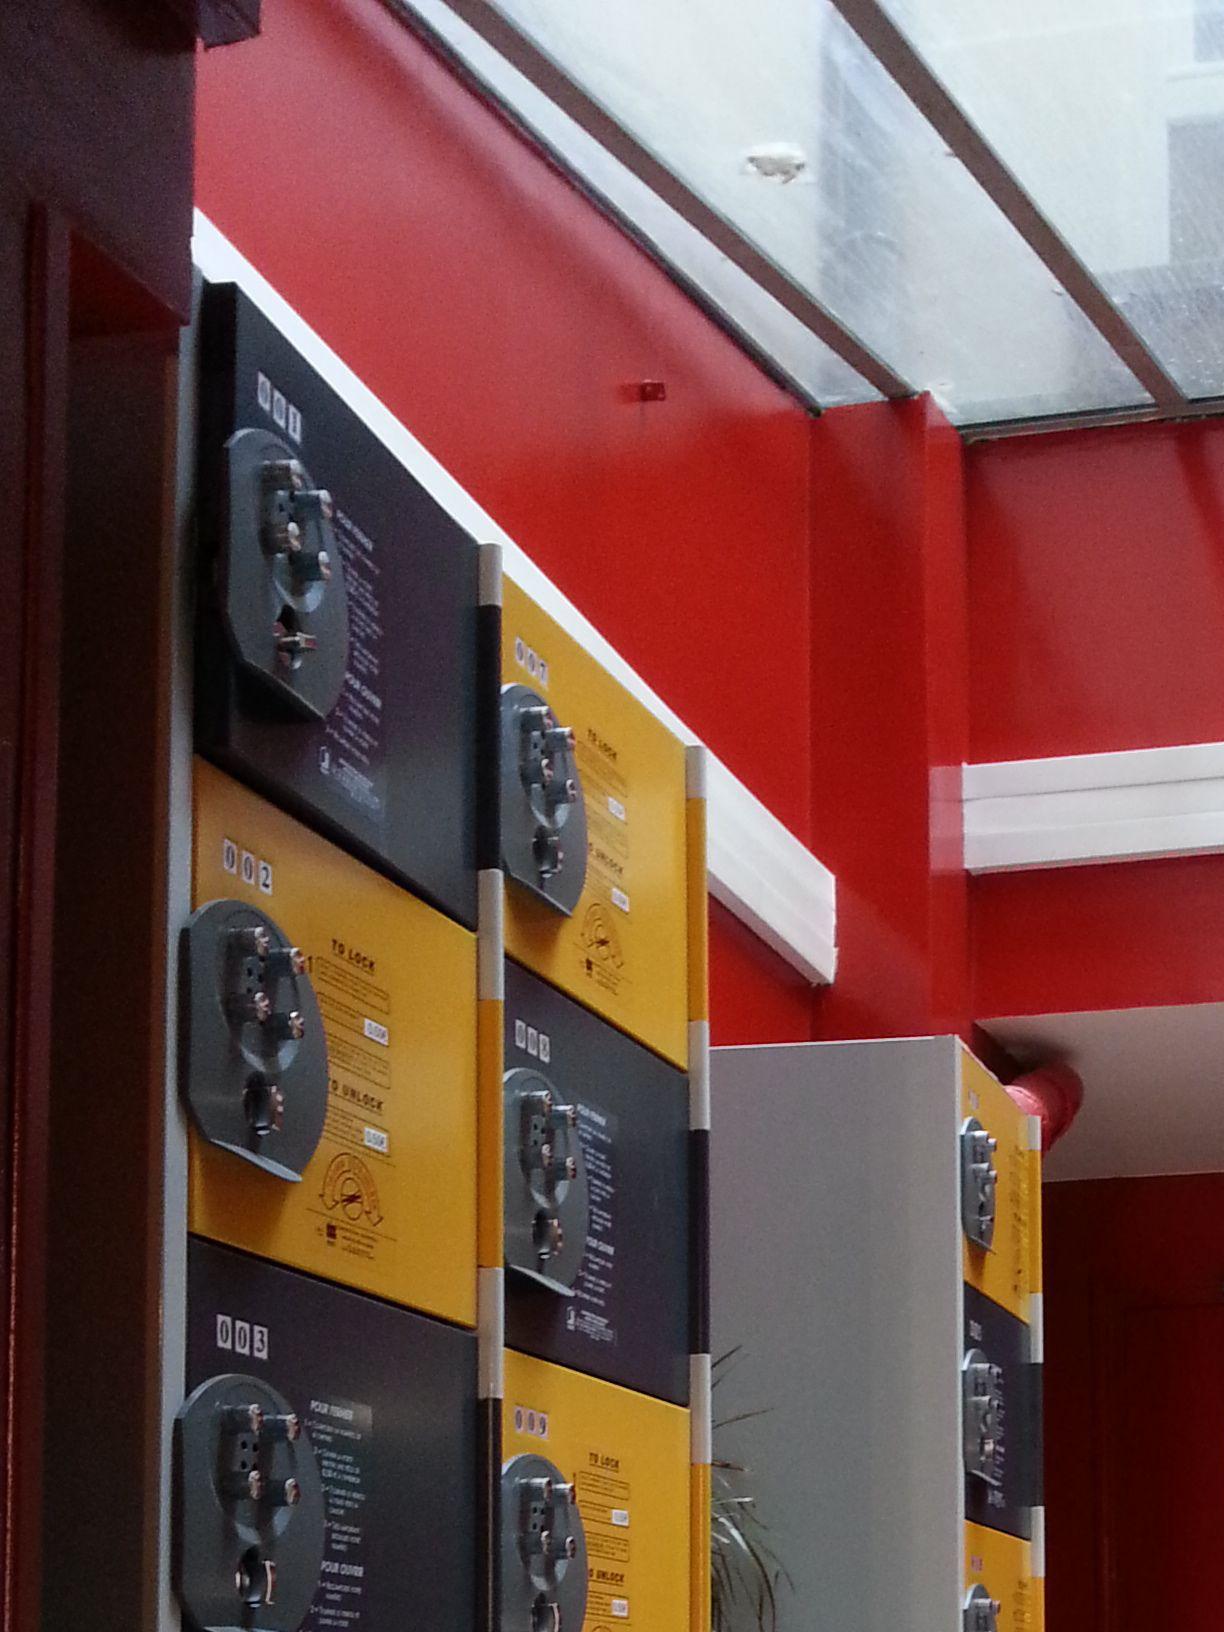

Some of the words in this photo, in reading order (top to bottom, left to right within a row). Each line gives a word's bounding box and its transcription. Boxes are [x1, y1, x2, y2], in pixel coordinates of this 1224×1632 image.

[224, 843, 271, 890] 002
[331, 938, 345, 955] TO
[348, 948, 376, 972] LOCK
[342, 1084, 383, 1112] UNLOCK
[218, 1318, 267, 1354] 003
[515, 1409, 547, 1436] 009
